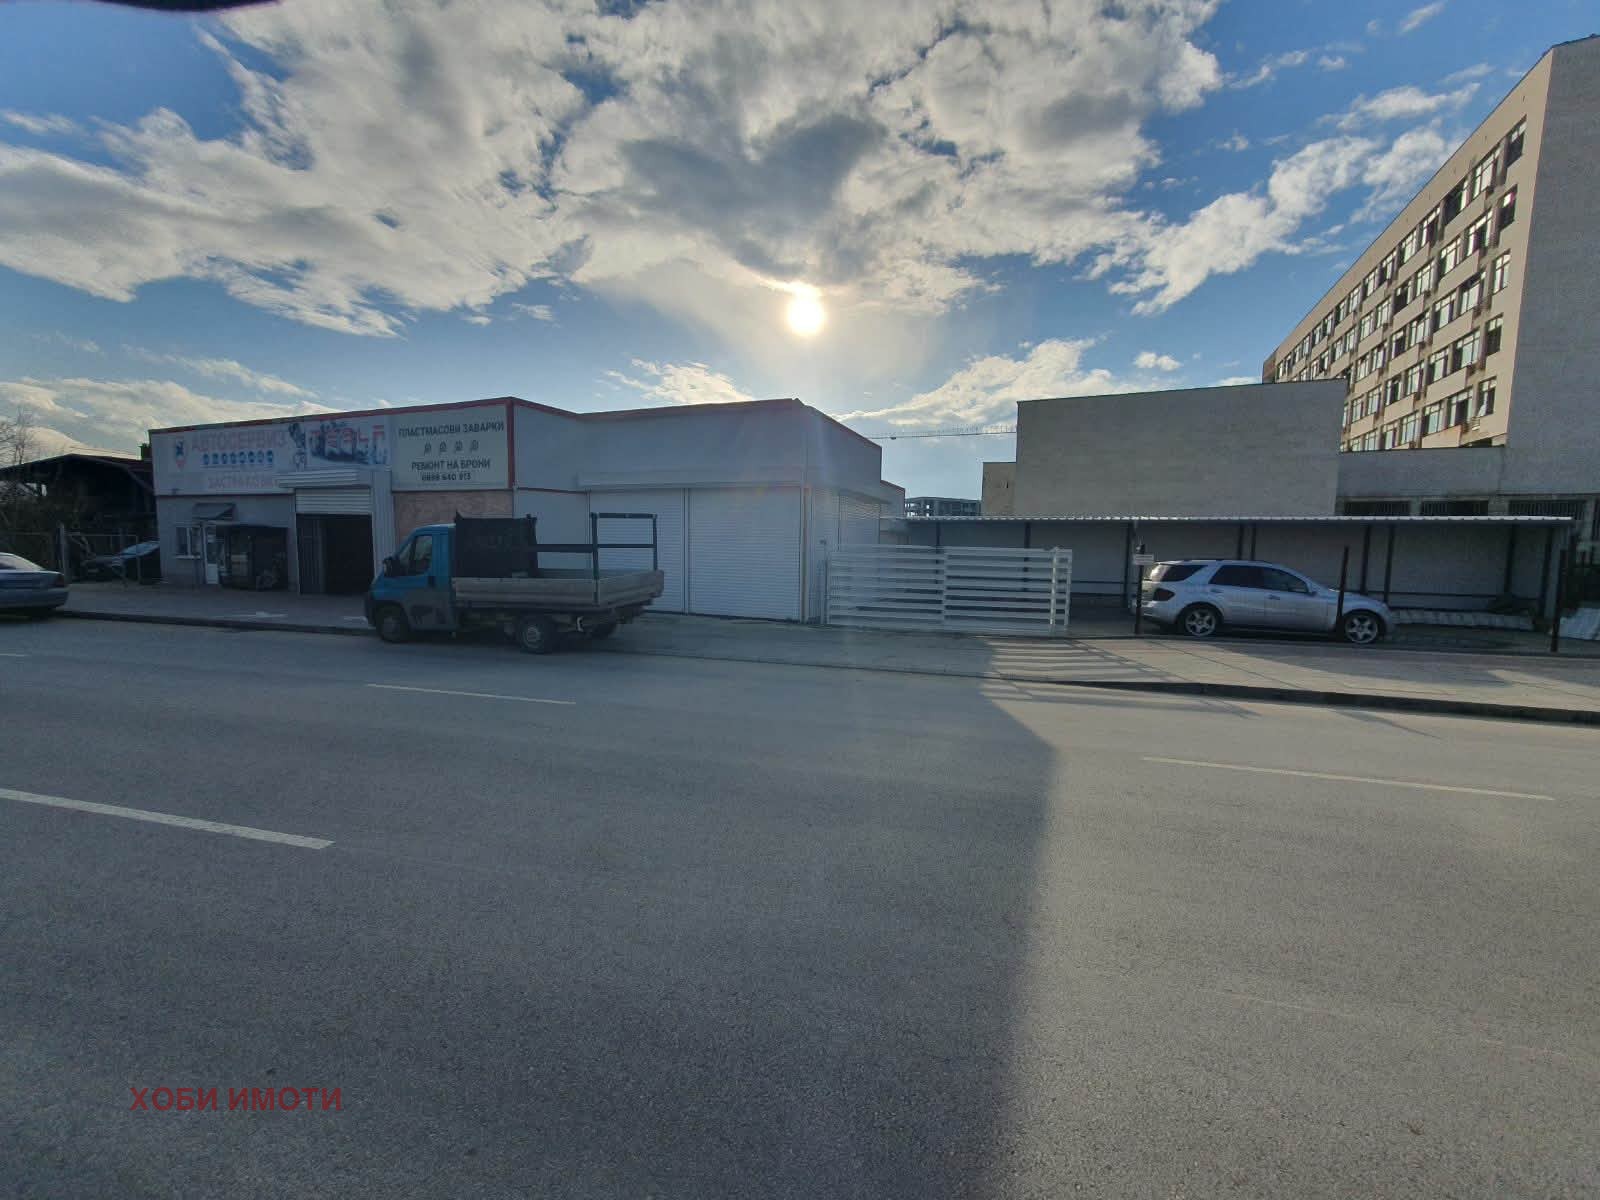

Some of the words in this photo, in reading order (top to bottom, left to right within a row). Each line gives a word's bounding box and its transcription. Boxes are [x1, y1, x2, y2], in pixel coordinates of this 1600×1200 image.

[399, 424, 460, 437] ПЛАСТМАСОВИ
[463, 421, 504, 433] ЗАВАРКИ
[412, 460, 444, 470] РЕМОНТ
[447, 460, 459, 470] НА
[461, 458, 490, 469] БРОНИ
